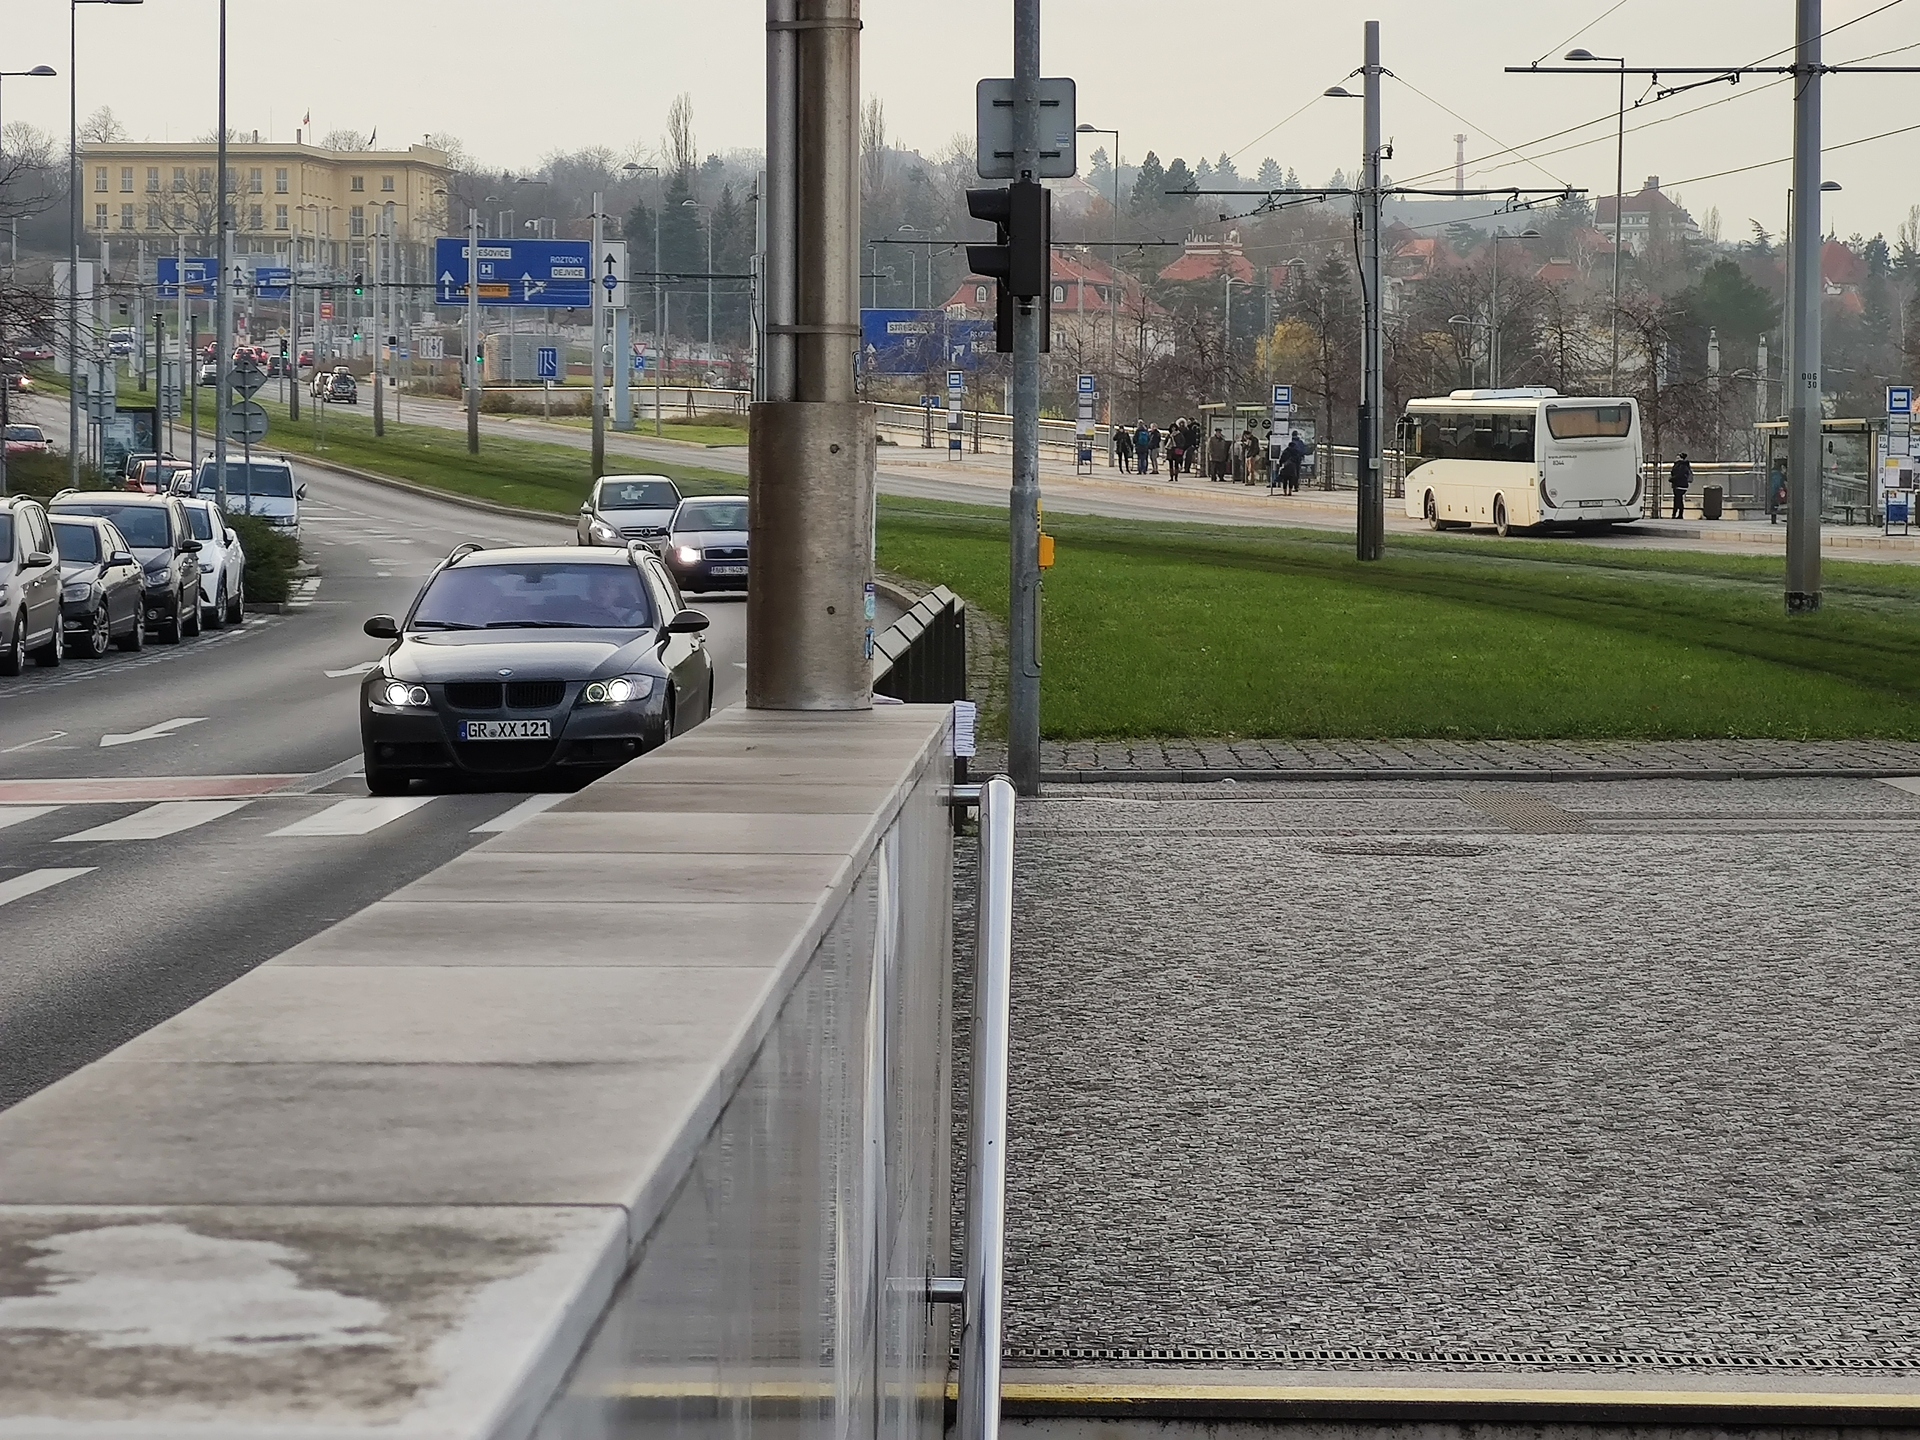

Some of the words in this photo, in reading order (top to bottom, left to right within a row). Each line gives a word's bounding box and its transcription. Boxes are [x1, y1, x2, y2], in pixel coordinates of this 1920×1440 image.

[464, 248, 509, 257] SEŠOVICE
[550, 256, 584, 264] ROZTOKY
[553, 268, 583, 277] DEJVICE
[1801, 372, 1817, 380] 006
[1807, 381, 1817, 389] 30
[1291, 404, 1296, 412] 3
[468, 722, 488, 738] GR
[498, 722, 518, 737] XX
[520, 722, 549, 737] 121
